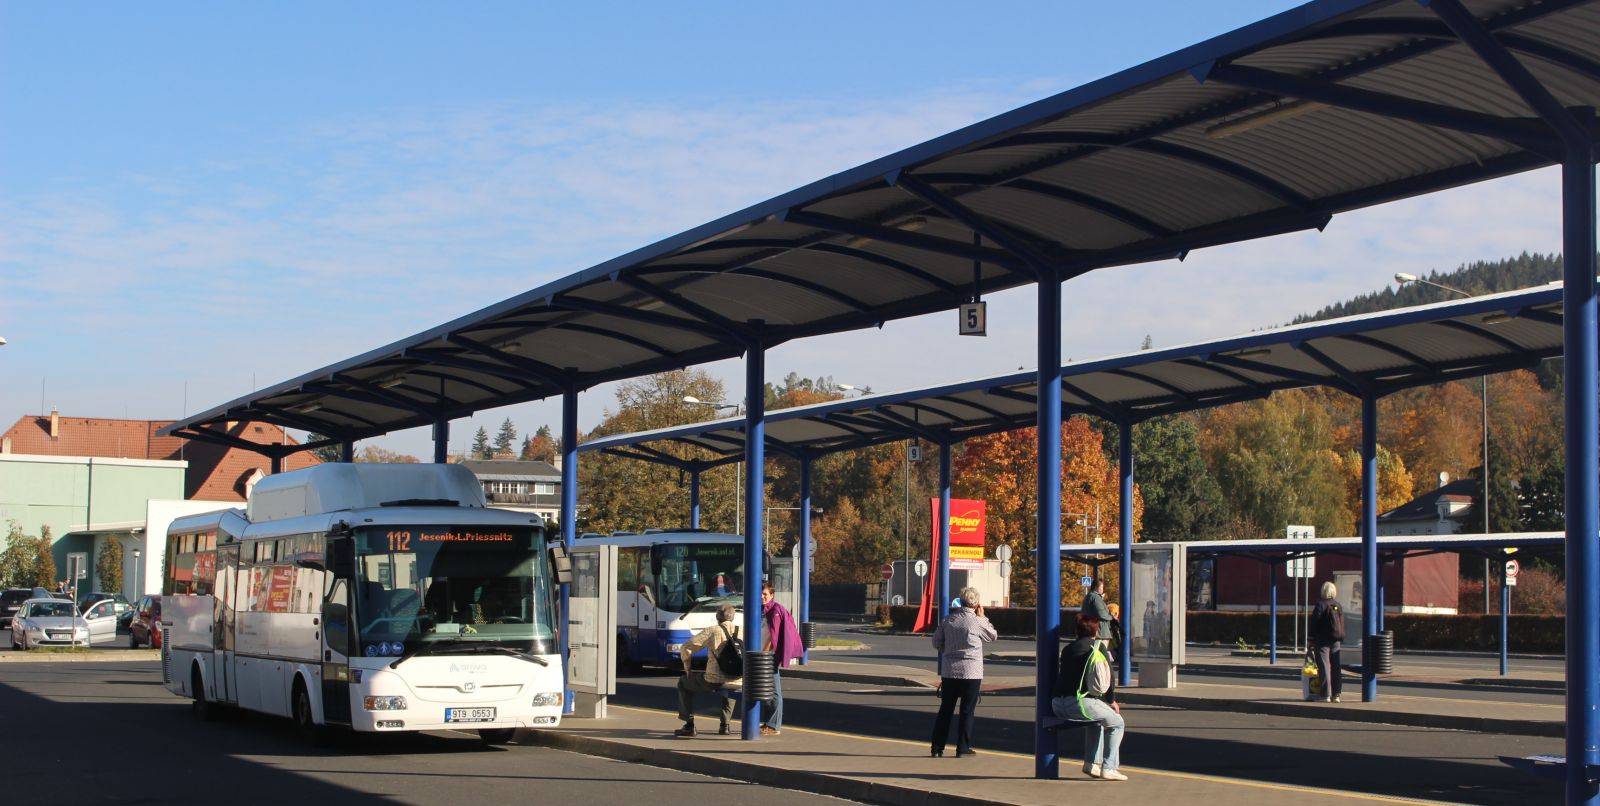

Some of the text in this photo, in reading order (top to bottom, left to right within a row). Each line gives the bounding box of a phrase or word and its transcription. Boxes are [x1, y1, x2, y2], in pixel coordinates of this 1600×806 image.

[967, 308, 978, 329] 5
[911, 448, 917, 459] 9
[949, 516, 981, 527] PENNY
[386, 530, 411, 551] 112
[472, 709, 491, 718] 0553
